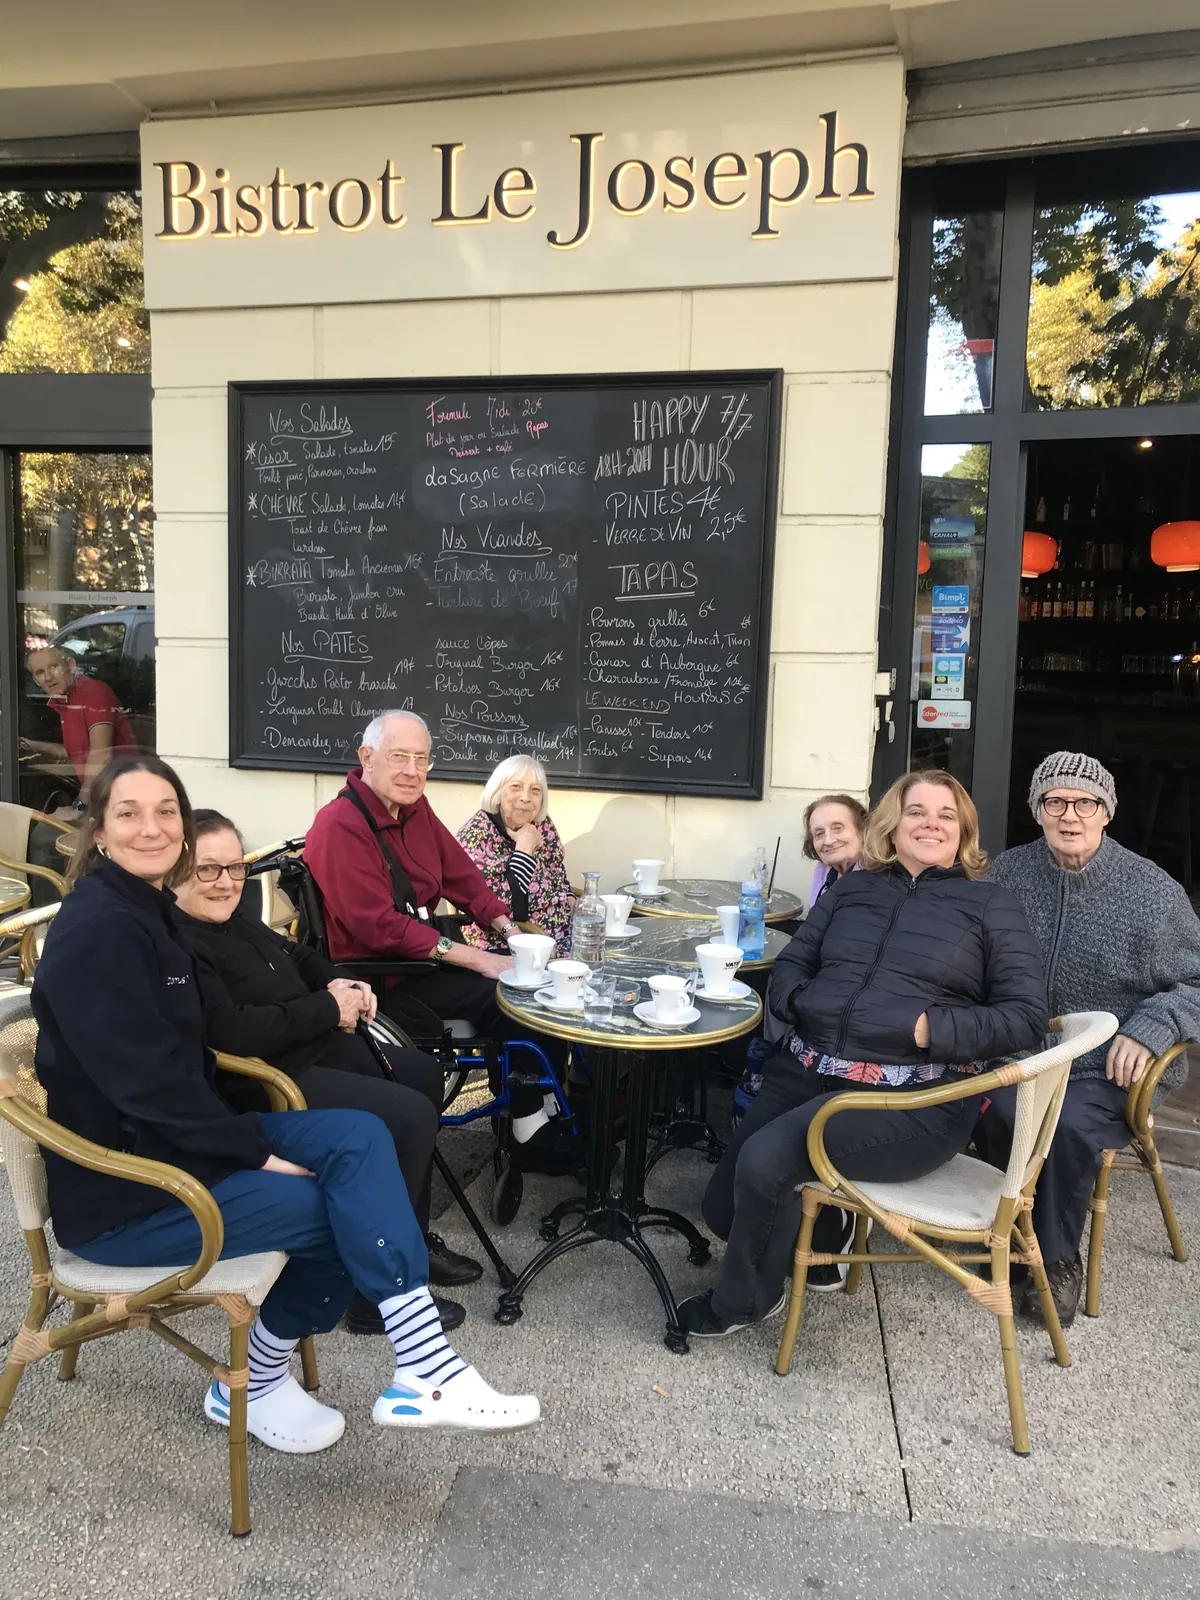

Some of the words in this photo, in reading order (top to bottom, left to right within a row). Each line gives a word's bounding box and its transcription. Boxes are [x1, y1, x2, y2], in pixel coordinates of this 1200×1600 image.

[153, 157, 407, 242] Bistrot
[431, 142, 537, 223] Le
[546, 110, 875, 250] Joseph
[269, 409, 294, 433] Nos
[300, 403, 351, 433] Salades
[426, 397, 471, 426] Formule
[486, 397, 510, 426] Midi
[522, 397, 542, 417] 20€
[633, 394, 711, 442] HAPPY
[720, 393, 754, 440] 7/7
[426, 432, 444, 448] Plat
[478, 432, 487, 440] ou
[491, 424, 520, 439] Salade
[449, 447, 480, 458] Dessert
[663, 436, 735, 486] HOUR
[606, 489, 684, 519] PINTES
[687, 486, 722, 517] 4€
[288, 519, 312, 535] Toast
[318, 522, 329, 533] de
[442, 526, 467, 550] Nos
[477, 522, 542, 548] Viandes
[605, 521, 646, 546] VERRE
[669, 517, 692, 541] VIN
[706, 508, 747, 541] 2,5€
[608, 560, 699, 594] TAPAS
[491, 590, 508, 608] de
[698, 598, 716, 617] 6€
[281, 630, 304, 654] Nos
[435, 638, 470, 649] sauce
[633, 633, 645, 647] de
[323, 669, 353, 690] Pesto
[489, 656, 540, 679] Burger
[435, 674, 481, 694] Potatoes
[487, 681, 534, 704] Burger
[586, 691, 602, 706] LE
[317, 697, 344, 716] Poulet
[446, 703, 467, 720] Nos
[470, 700, 524, 724] Poissons
[264, 727, 330, 755] Demandez
[645, 722, 690, 739] Tenders
[692, 721, 713, 733] 10€
[485, 749, 498, 761] de
[621, 741, 634, 753] 6€
